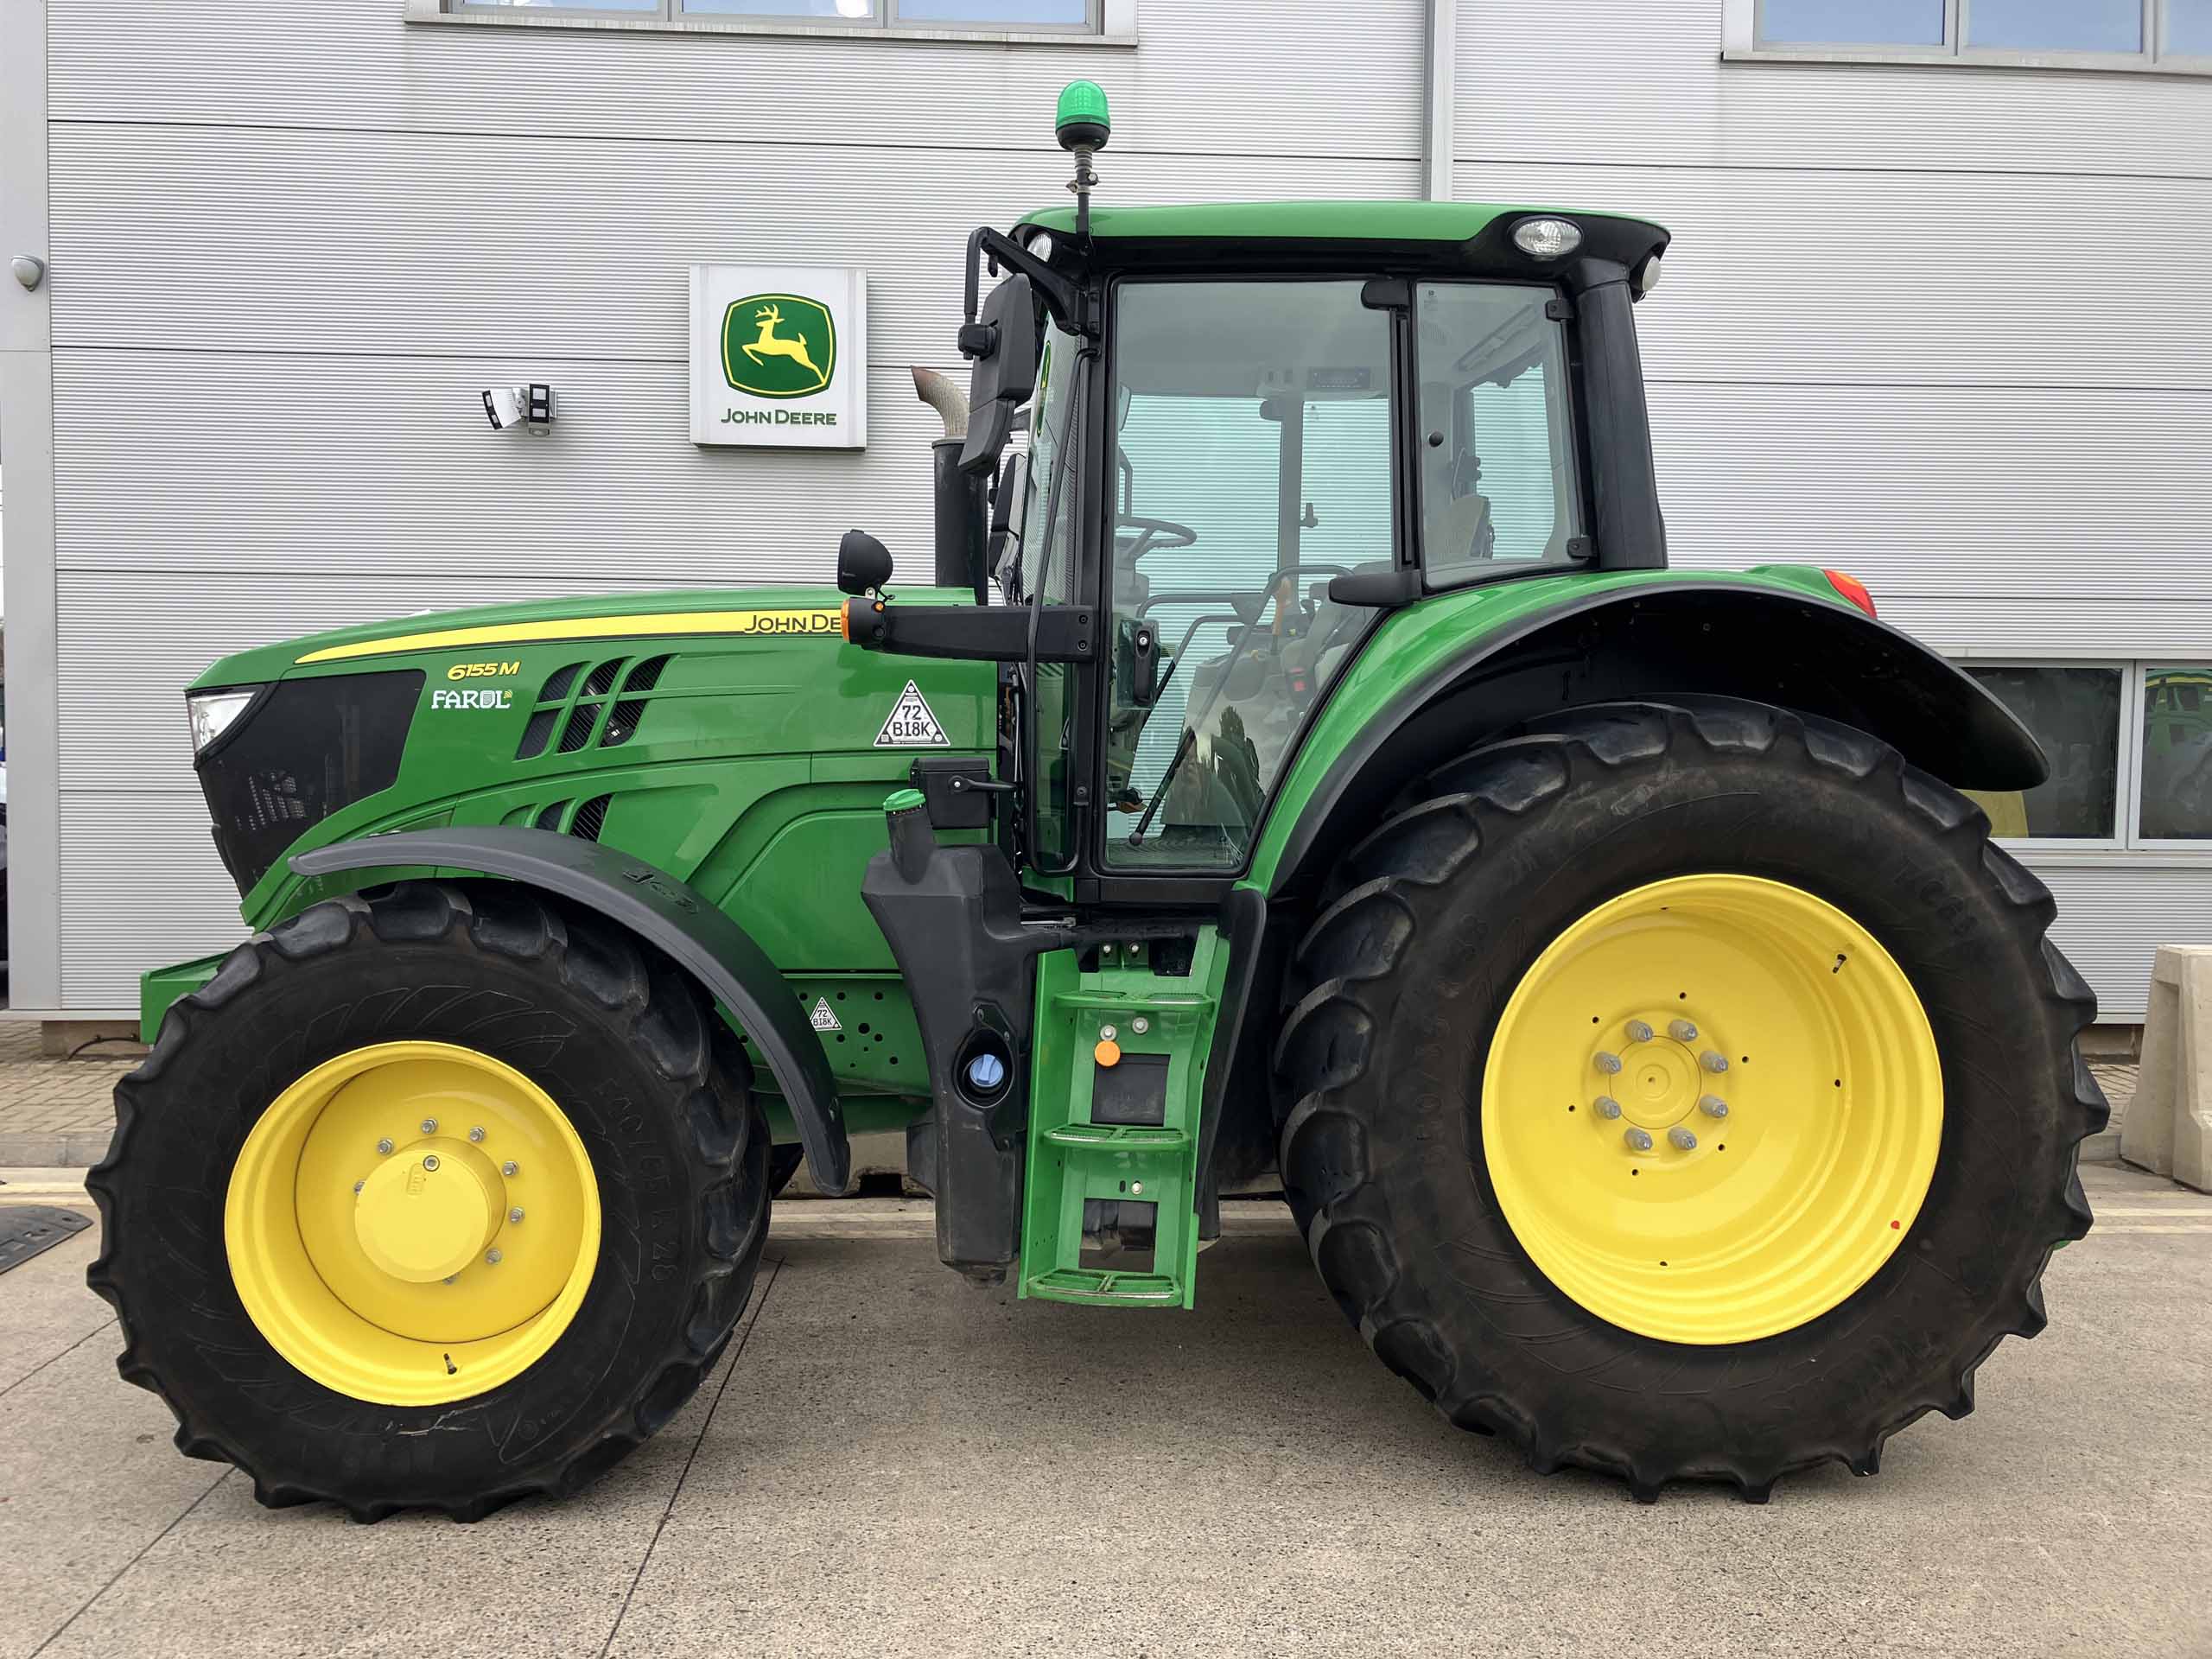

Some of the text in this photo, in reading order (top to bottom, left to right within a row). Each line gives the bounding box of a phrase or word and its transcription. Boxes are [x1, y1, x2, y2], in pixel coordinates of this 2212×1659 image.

[721, 408, 837, 426] JOHN DEERE
[744, 613, 842, 632] JOHN DE
[431, 690, 512, 709] FAROL
[902, 705, 922, 721] 72
[817, 1009, 828, 1018] 72
